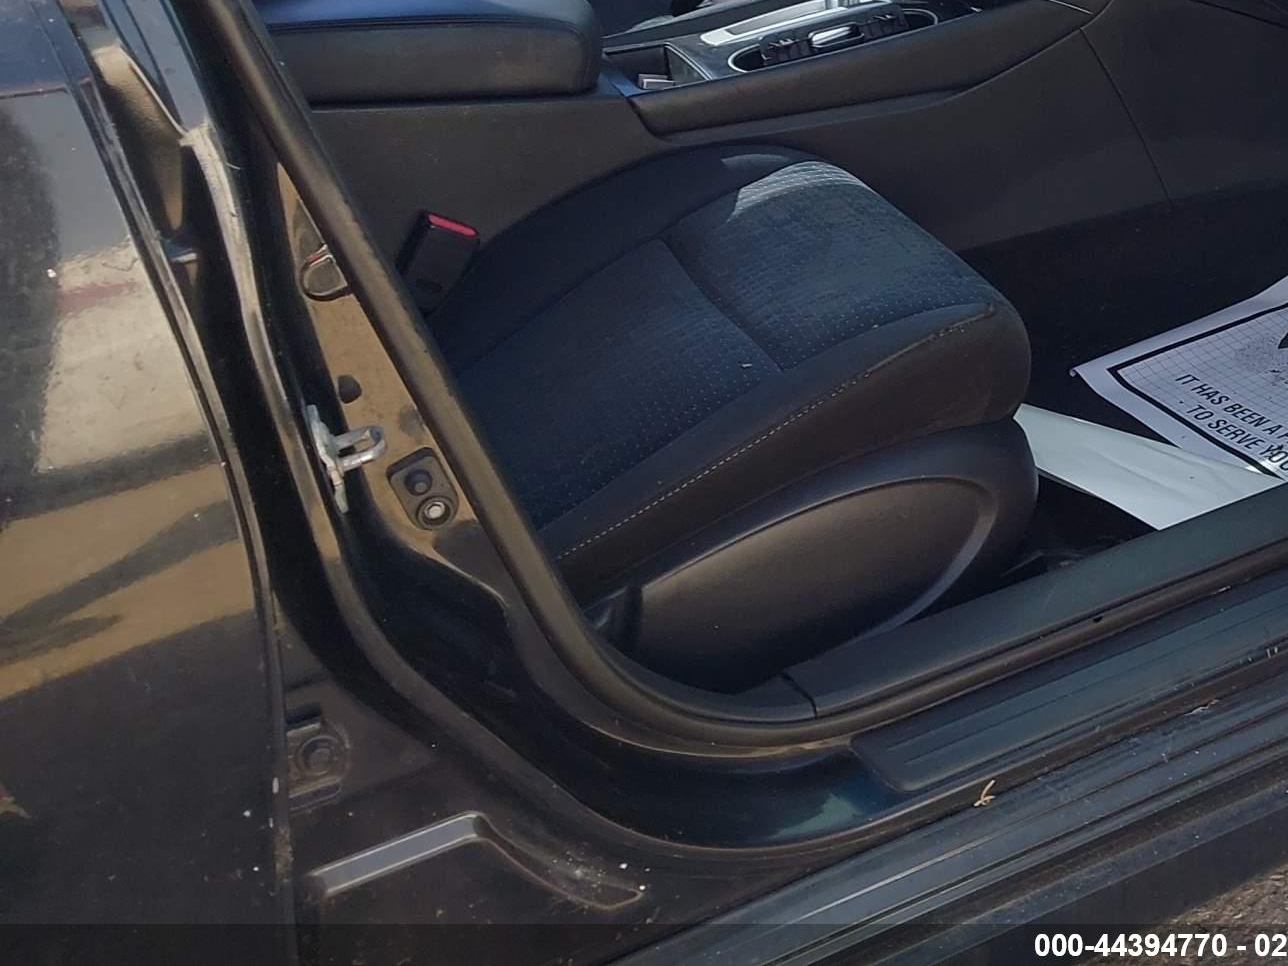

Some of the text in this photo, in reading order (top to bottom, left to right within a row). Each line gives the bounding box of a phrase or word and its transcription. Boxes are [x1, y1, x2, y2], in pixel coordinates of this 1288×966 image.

[1175, 374, 1201, 385] IT
[1191, 384, 1230, 405] HAS
[1223, 403, 1271, 428] BEEN
[1262, 424, 1283, 435] A
[1187, 404, 1214, 420] TO
[1207, 419, 1265, 450] SERVE
